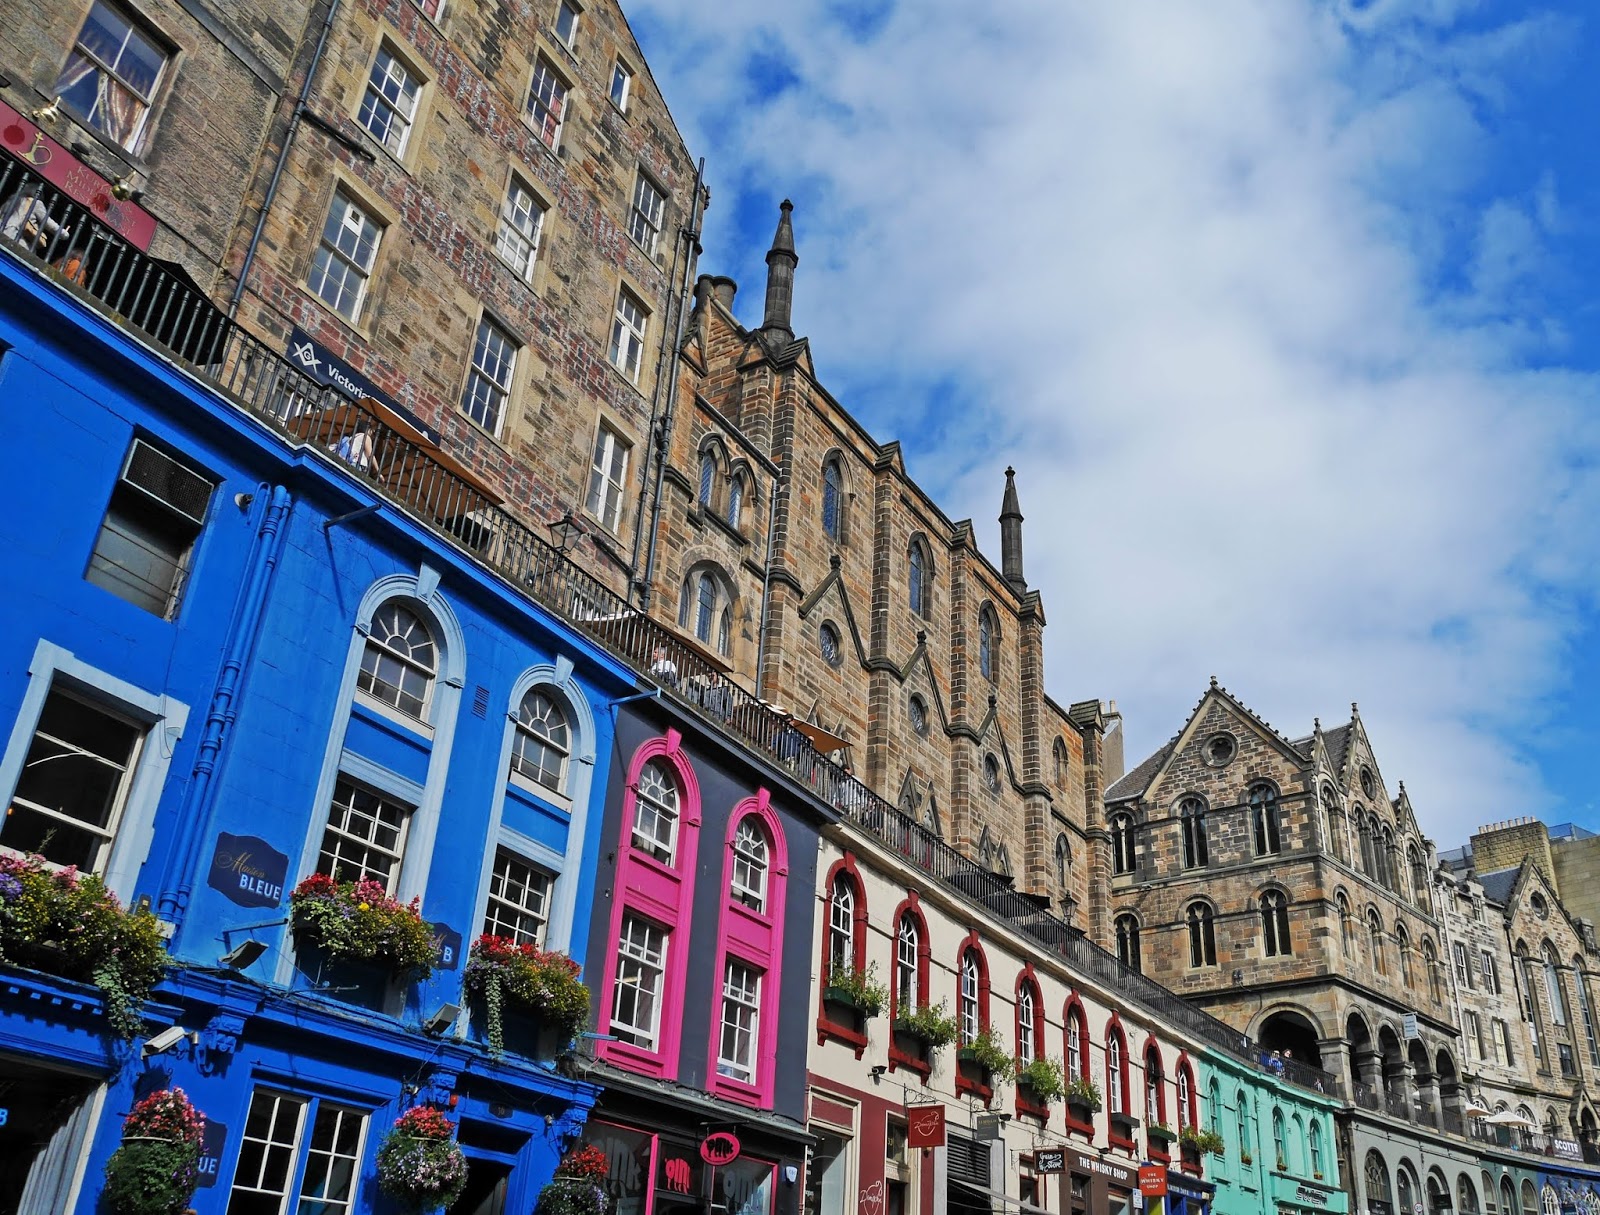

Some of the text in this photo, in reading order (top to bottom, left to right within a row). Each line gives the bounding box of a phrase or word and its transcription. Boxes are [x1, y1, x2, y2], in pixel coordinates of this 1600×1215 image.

[77, 166, 125, 206] KURDH
[239, 873, 281, 900] BLEUE
[1554, 1139, 1579, 1153] SCOTTS
[1078, 1156, 1128, 1180] THE WHISKY SHOP
